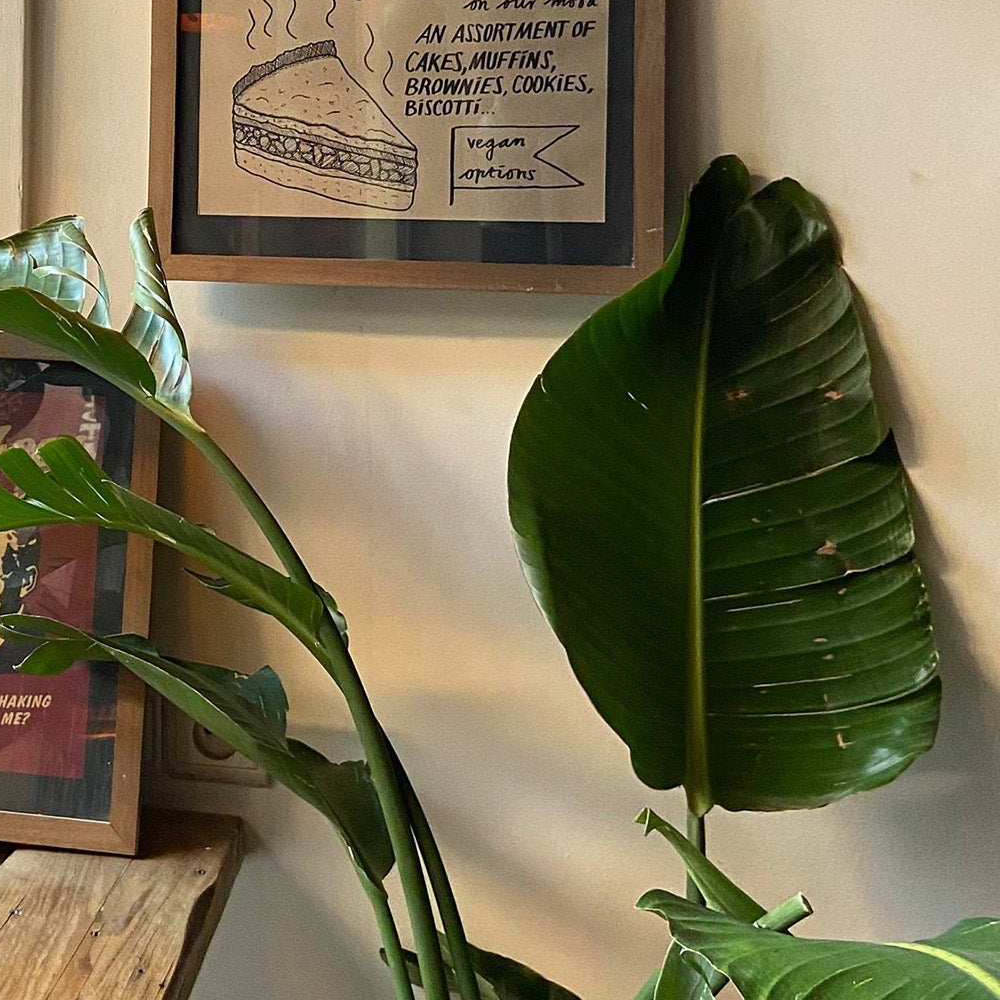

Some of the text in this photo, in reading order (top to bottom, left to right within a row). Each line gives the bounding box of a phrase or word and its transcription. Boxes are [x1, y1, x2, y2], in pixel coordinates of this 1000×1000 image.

[415, 20, 597, 44] AN ASSORTMENT OF
[404, 49, 557, 74] CAKES, MUFFINS,
[404, 73, 594, 97] BROWNIES, COOKIES,
[404, 98, 496, 117] BISCOTTI...
[466, 134, 525, 161] vegan
[458, 165, 536, 184] options
[0, 711, 31, 725] ME?
